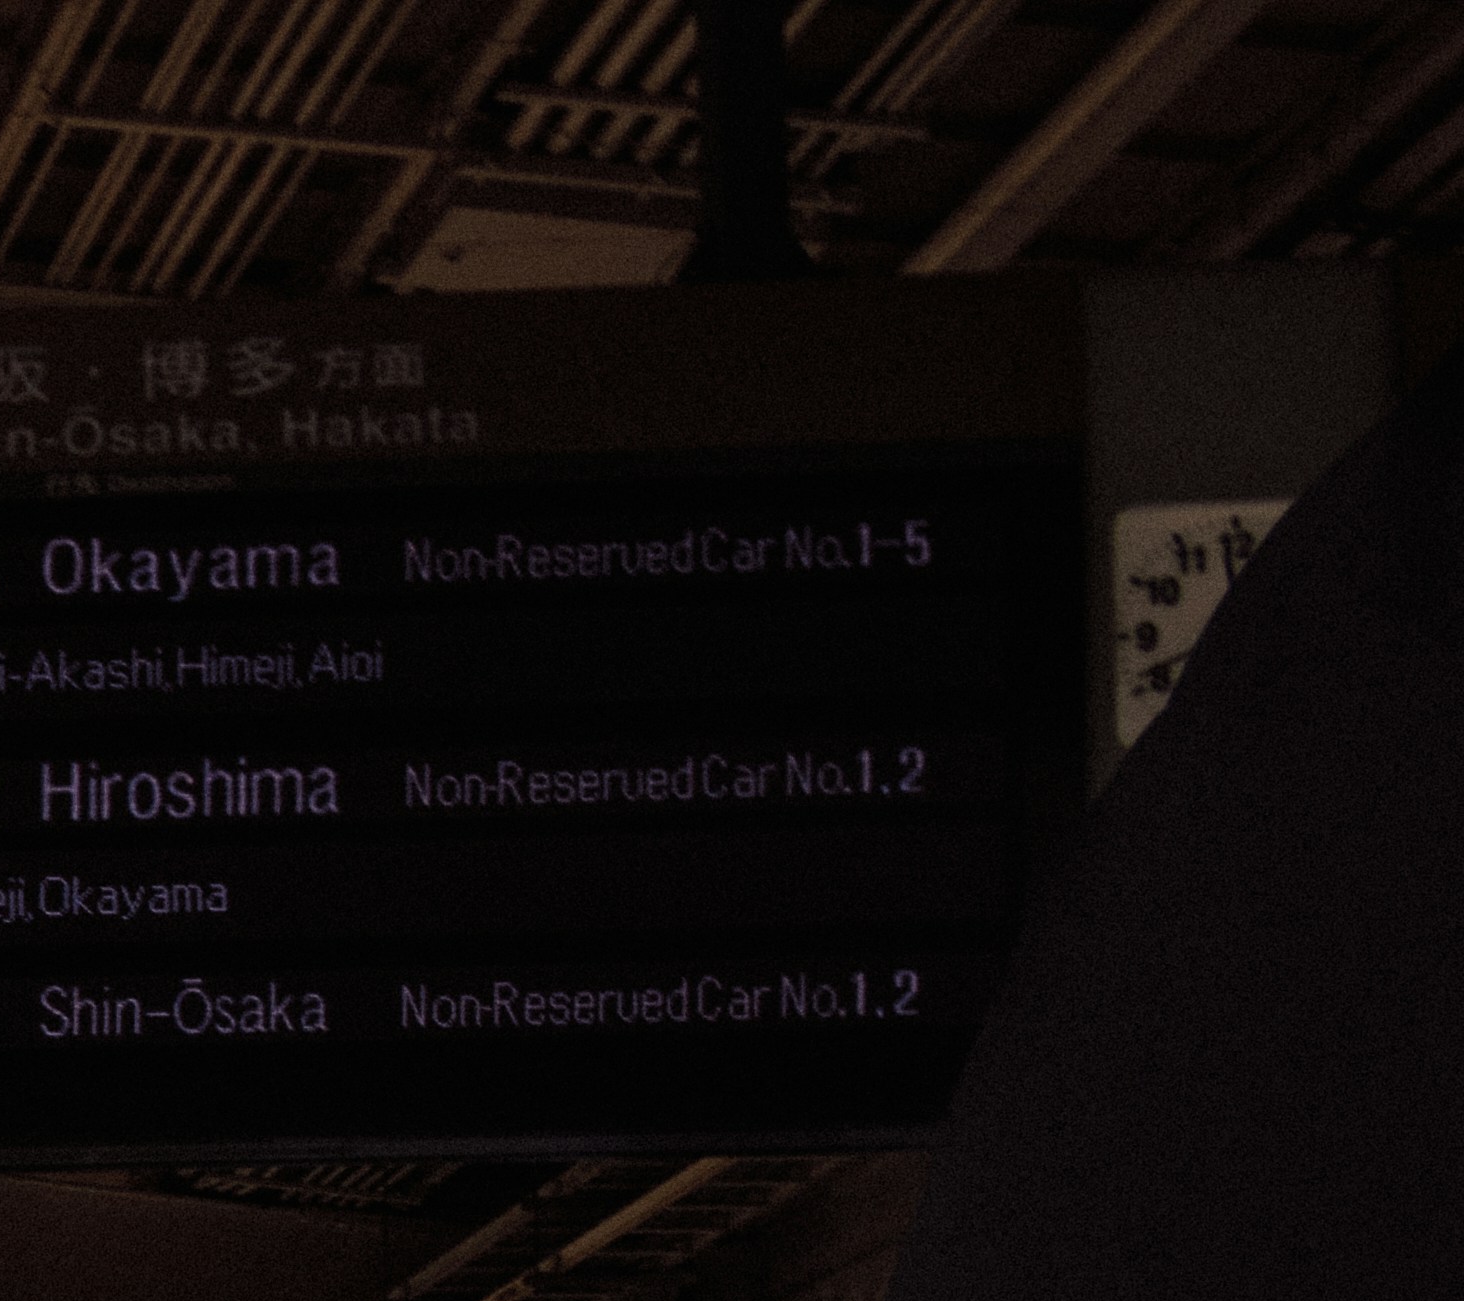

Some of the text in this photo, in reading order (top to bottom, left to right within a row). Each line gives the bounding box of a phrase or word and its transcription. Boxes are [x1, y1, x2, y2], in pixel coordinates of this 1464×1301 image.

[282, 398, 479, 450] Hakata
[41, 537, 340, 602] Okayama
[39, 756, 341, 822] Hiroshima
[39, 976, 329, 1040] Shin-Ōsaka
